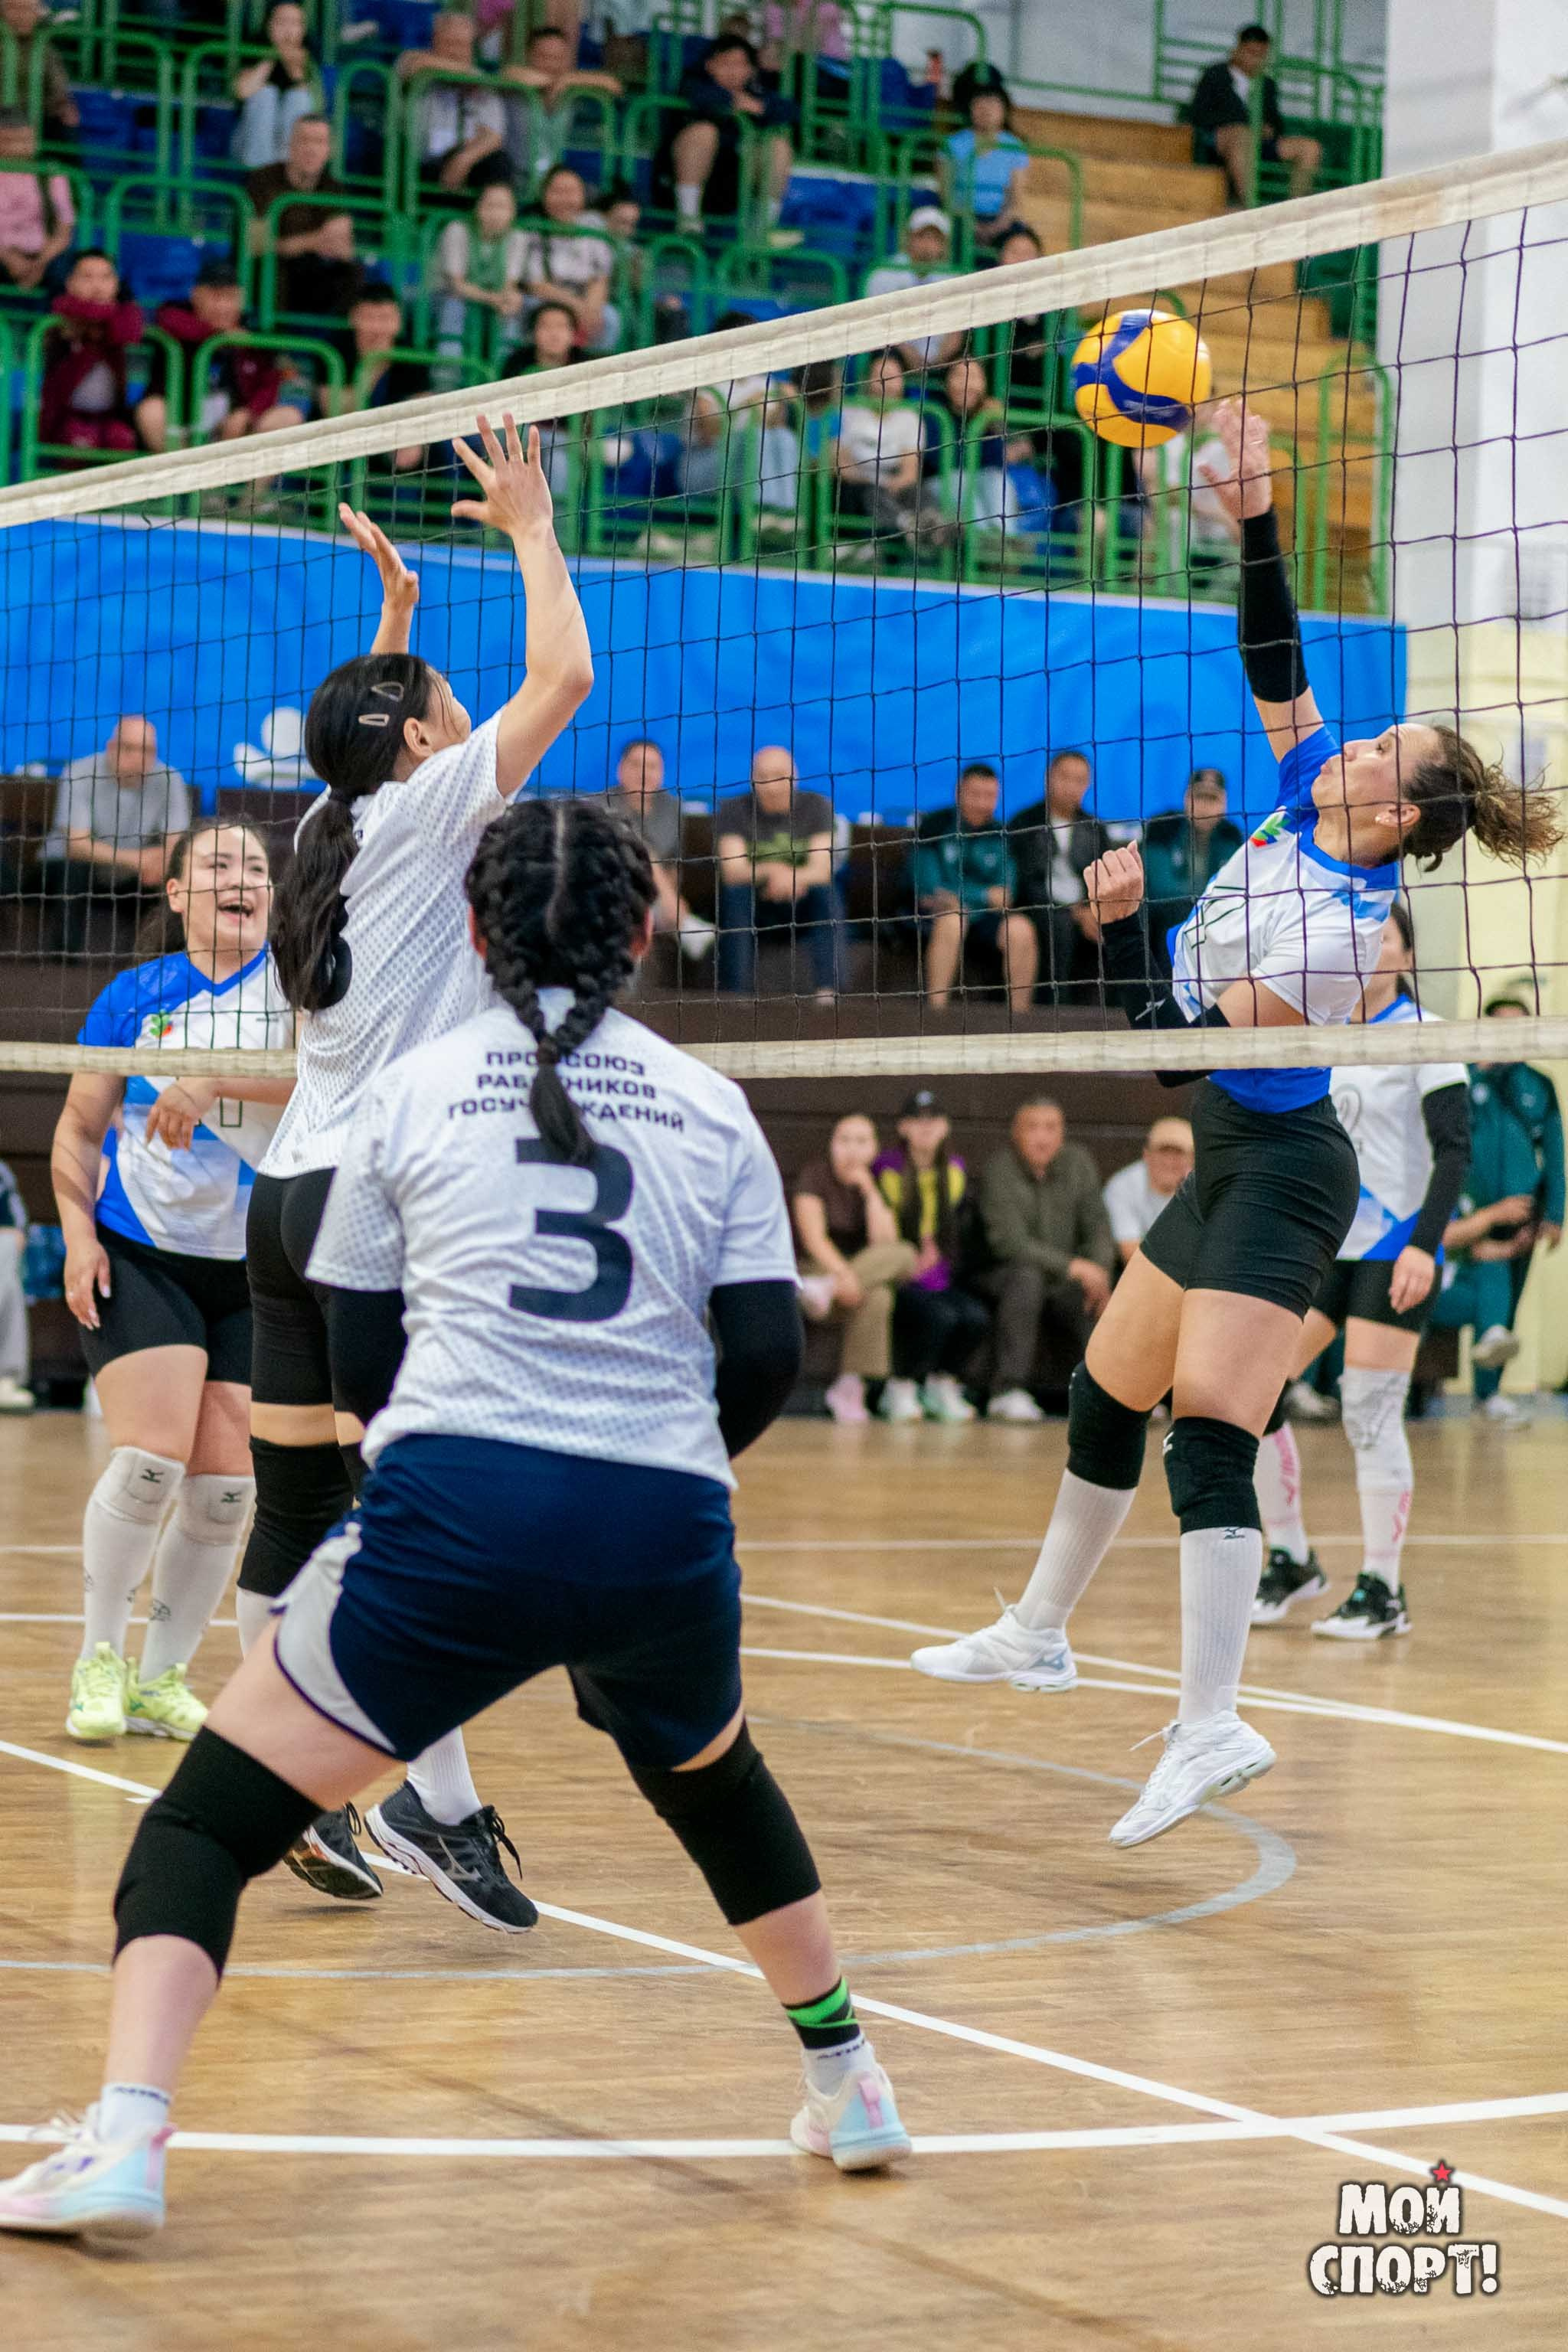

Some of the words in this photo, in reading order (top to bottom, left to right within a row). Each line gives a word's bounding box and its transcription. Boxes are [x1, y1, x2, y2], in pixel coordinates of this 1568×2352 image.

[486, 1050, 645, 1076] ПРОСОЮЗ
[476, 1073, 656, 1099] РАБНИКОВ
[508, 1138, 635, 1322] 3
